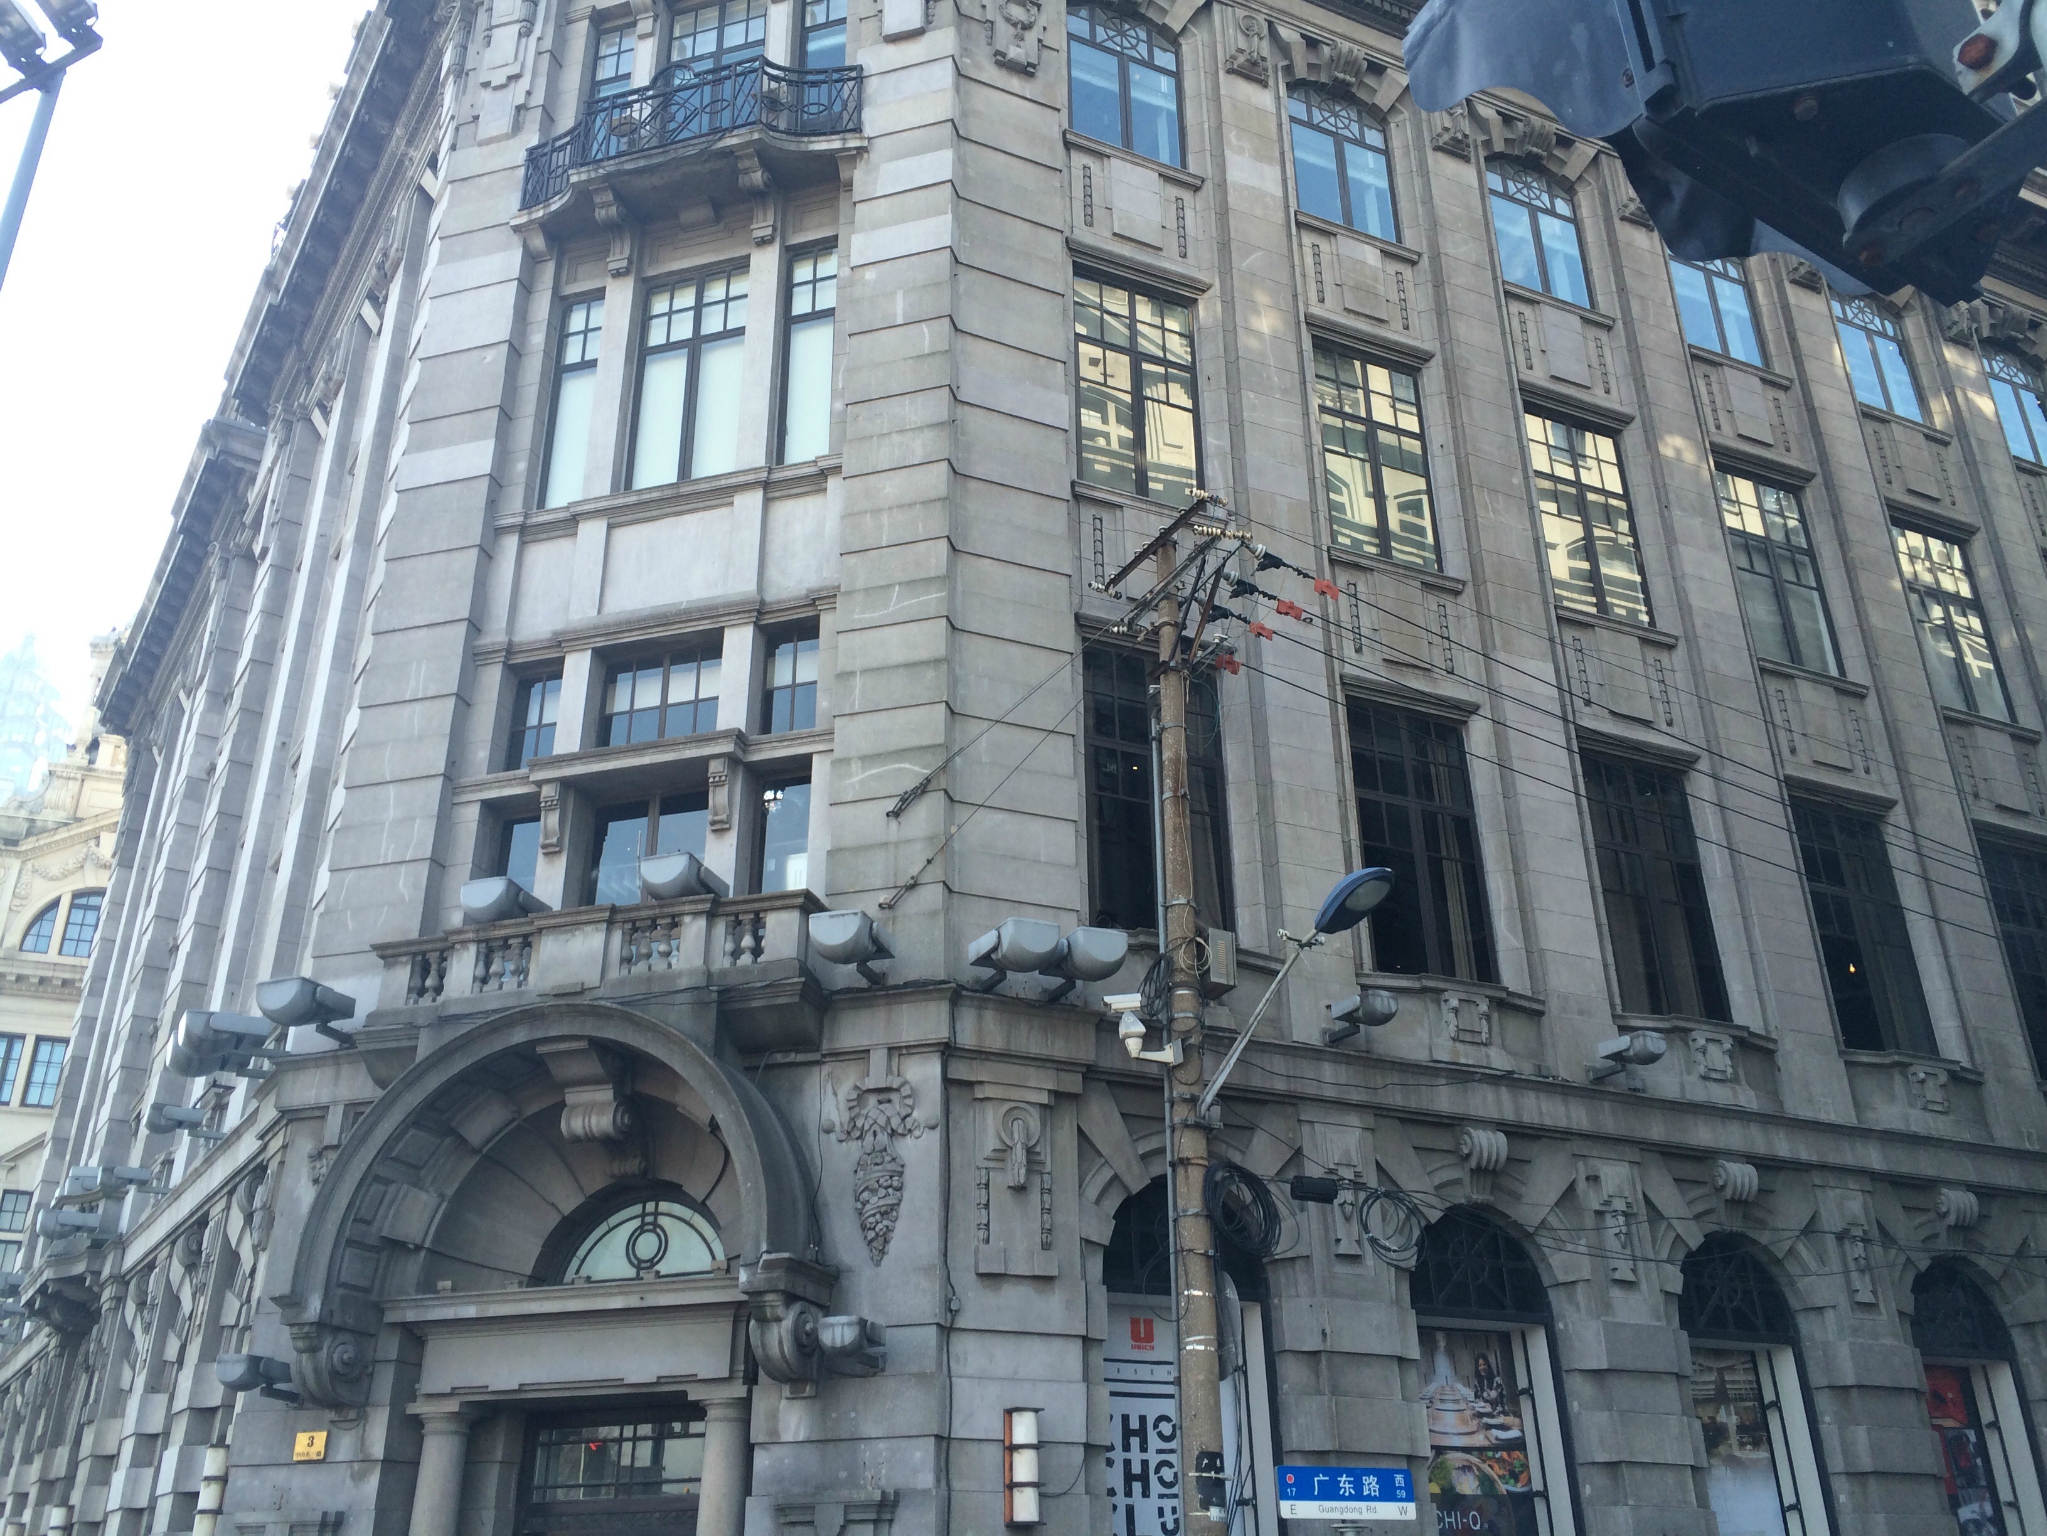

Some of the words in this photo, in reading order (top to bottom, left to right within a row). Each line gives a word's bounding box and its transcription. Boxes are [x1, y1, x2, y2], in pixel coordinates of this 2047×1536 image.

[307, 1435, 315, 1447] 3
[1314, 1474, 1379, 1497] 广东路
[1394, 1474, 1405, 1487] 西
[1287, 1488, 1296, 1496] 17
[1396, 1490, 1406, 1498] 59
[1290, 1504, 1297, 1515] E
[1318, 1505, 1363, 1515] Guangdong
[1398, 1506, 1408, 1516] W
